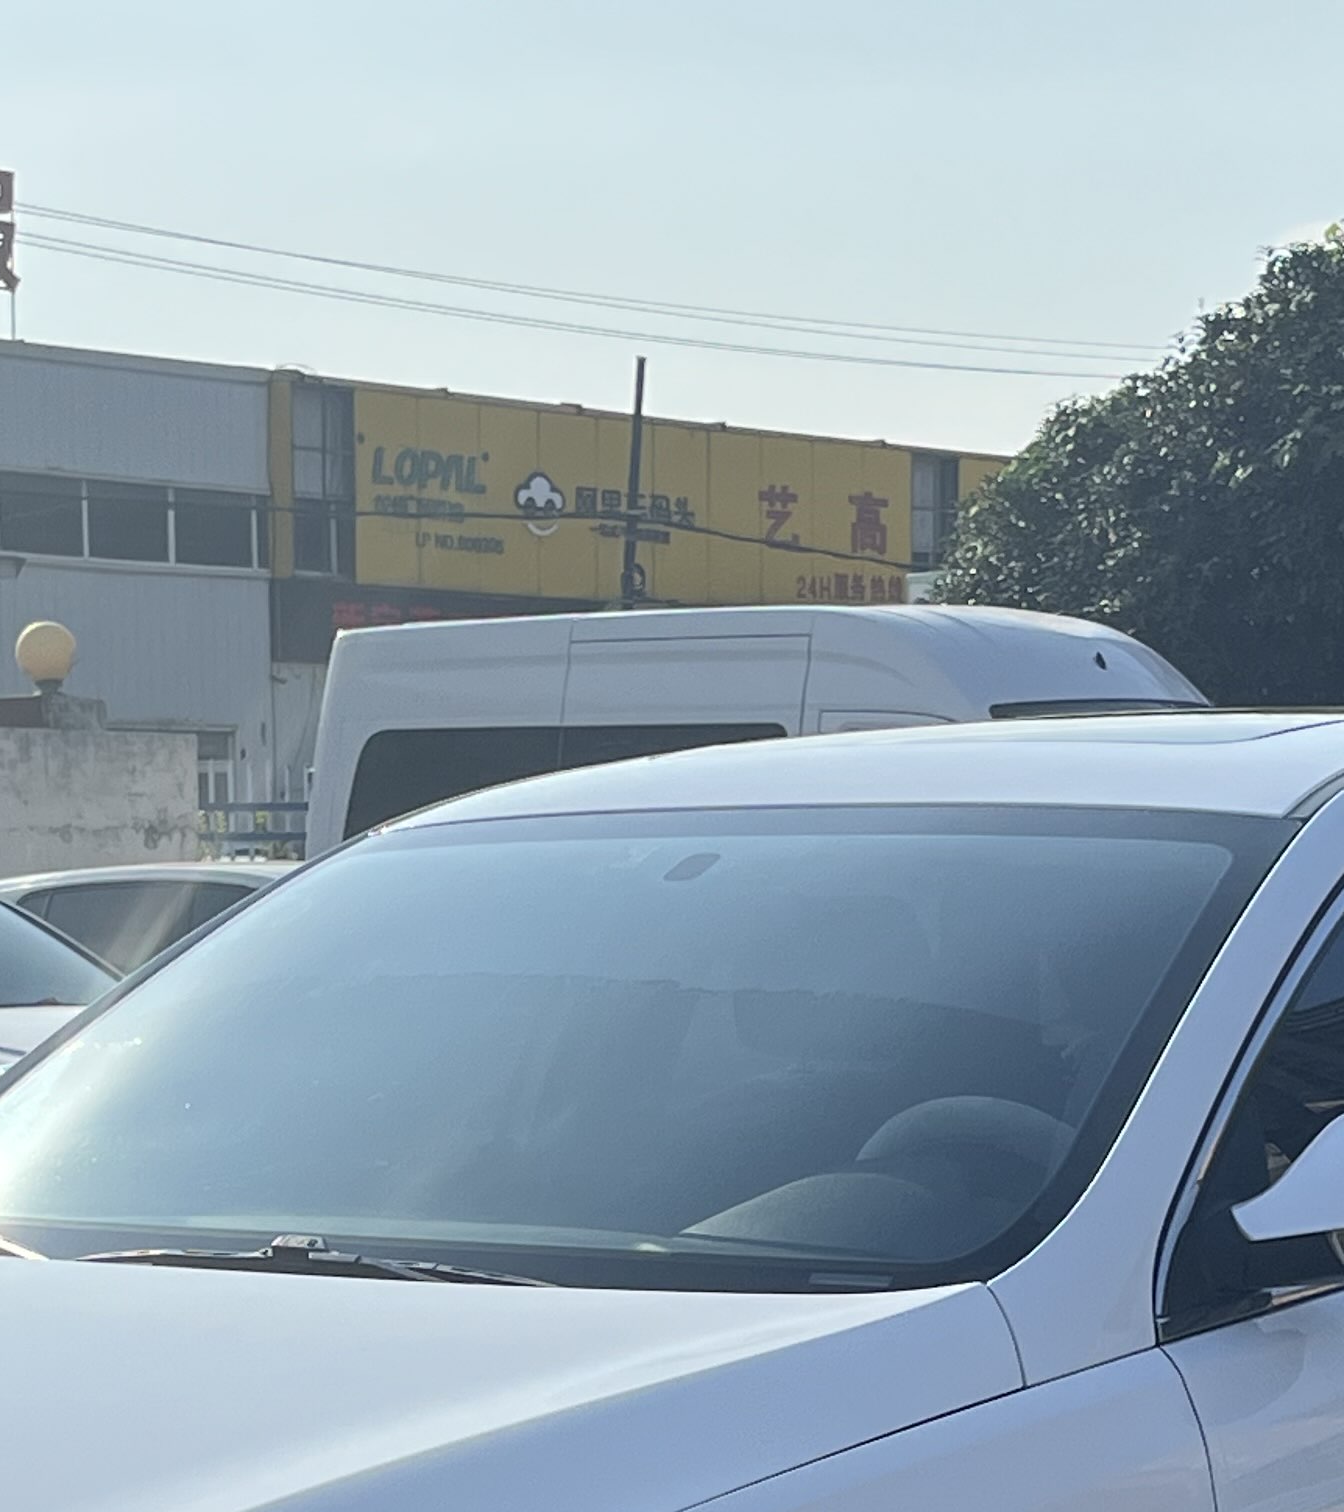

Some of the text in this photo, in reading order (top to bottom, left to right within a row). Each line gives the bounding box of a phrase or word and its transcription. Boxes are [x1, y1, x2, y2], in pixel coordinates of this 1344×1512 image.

[371, 445, 488, 495] LOPAL
[575, 485, 697, 529] 阿里码头
[757, 483, 890, 556] 艺高
